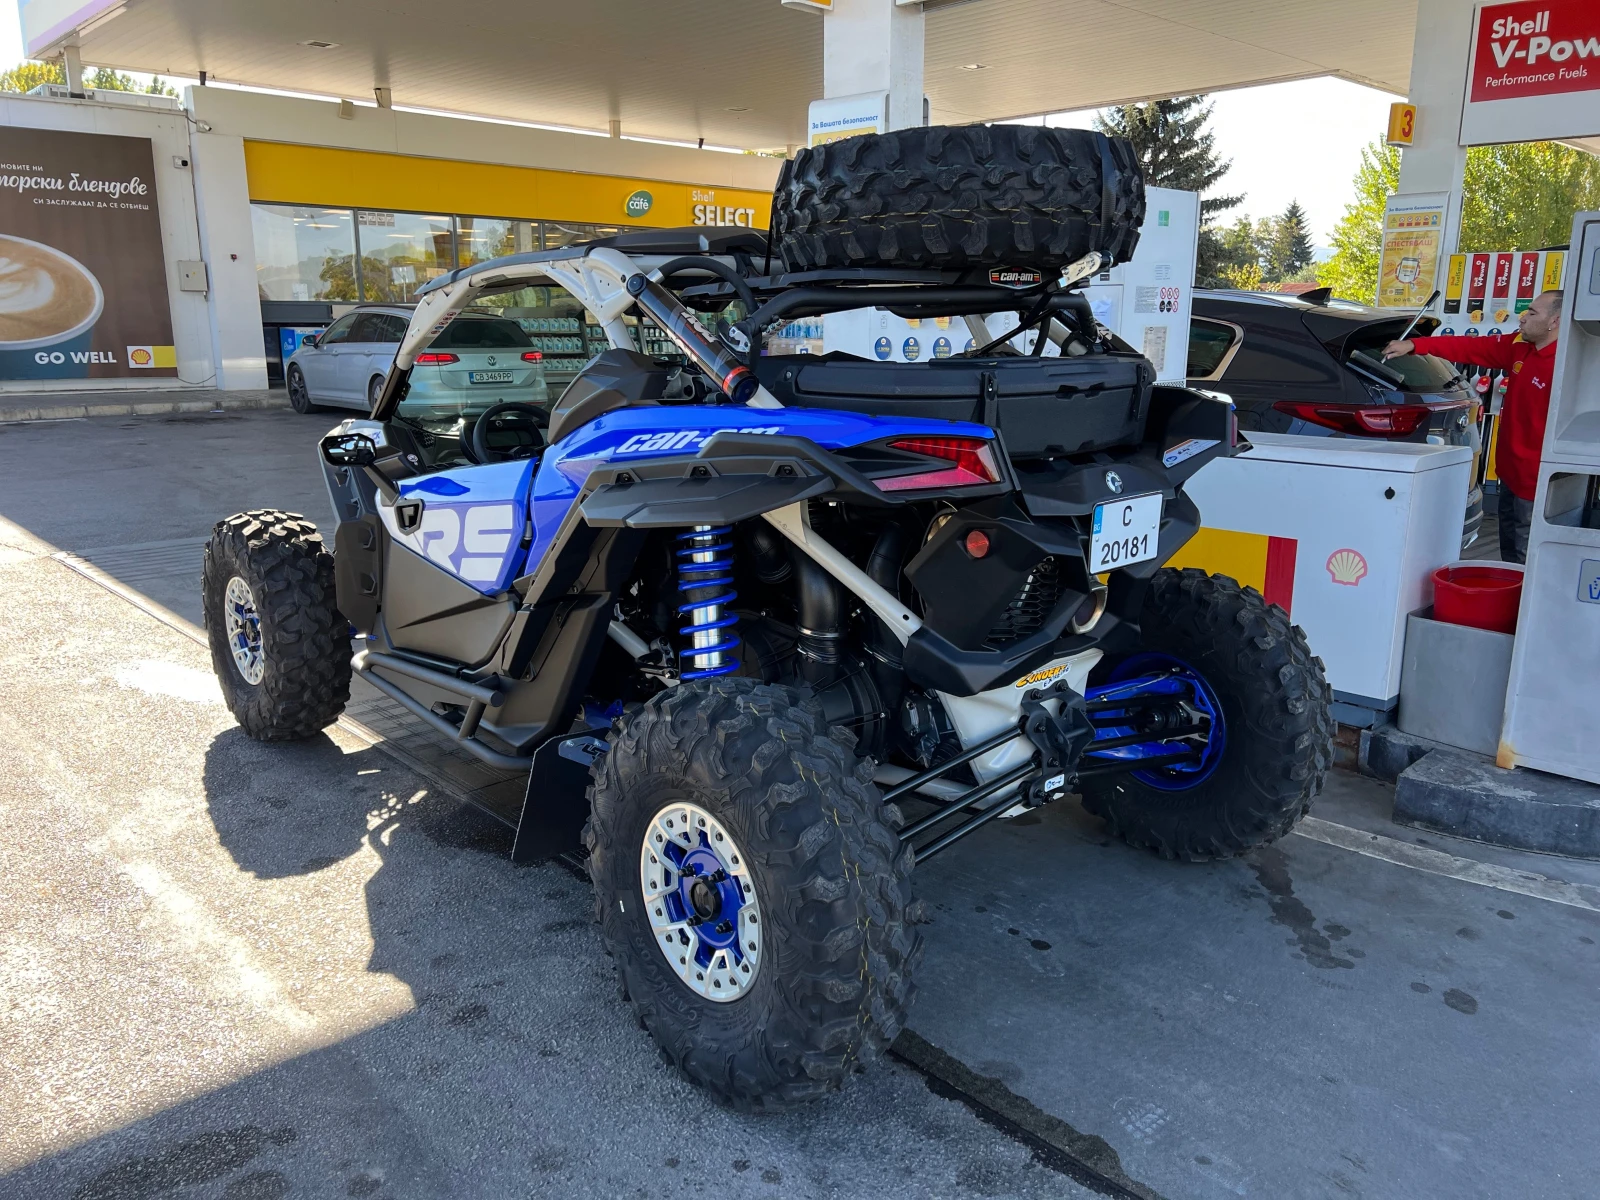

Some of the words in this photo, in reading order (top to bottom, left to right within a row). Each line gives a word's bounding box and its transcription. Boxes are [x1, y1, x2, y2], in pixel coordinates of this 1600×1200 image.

[1491, 10, 1550, 39] Shell
[1485, 72, 1556, 88] Performance
[1558, 65, 1588, 80] Fuels
[820, 120, 842, 129] Вашата
[842, 115, 879, 125] безопасност
[1402, 109, 1413, 138] 3
[0, 163, 30, 171] НОВИТЕ
[68, 172, 148, 198] блендове
[692, 190, 715, 203] Shell
[46, 198, 95, 207] ЗАСЛУЖАВАТ
[629, 198, 649, 210] café
[694, 204, 755, 228] SELECT
[1386, 240, 1433, 248] СПЕСТЯВАШ
[1000, 272, 1034, 282] can-am
[1454, 261, 1463, 287] FuelSave
[1477, 262, 1486, 287] V-Power
[1501, 261, 1510, 287] V-Power
[1525, 261, 1535, 287] V-Power
[1551, 258, 1560, 285] FuelSave
[34, 351, 65, 364] GO
[70, 351, 118, 364] WELL
[485, 372, 502, 381] 3469
[502, 372, 512, 381] PP
[1094, 523, 1101, 532] BG
[1122, 505, 1133, 527] C
[421, 504, 513, 582] RS
[1100, 533, 1149, 566] 20181
